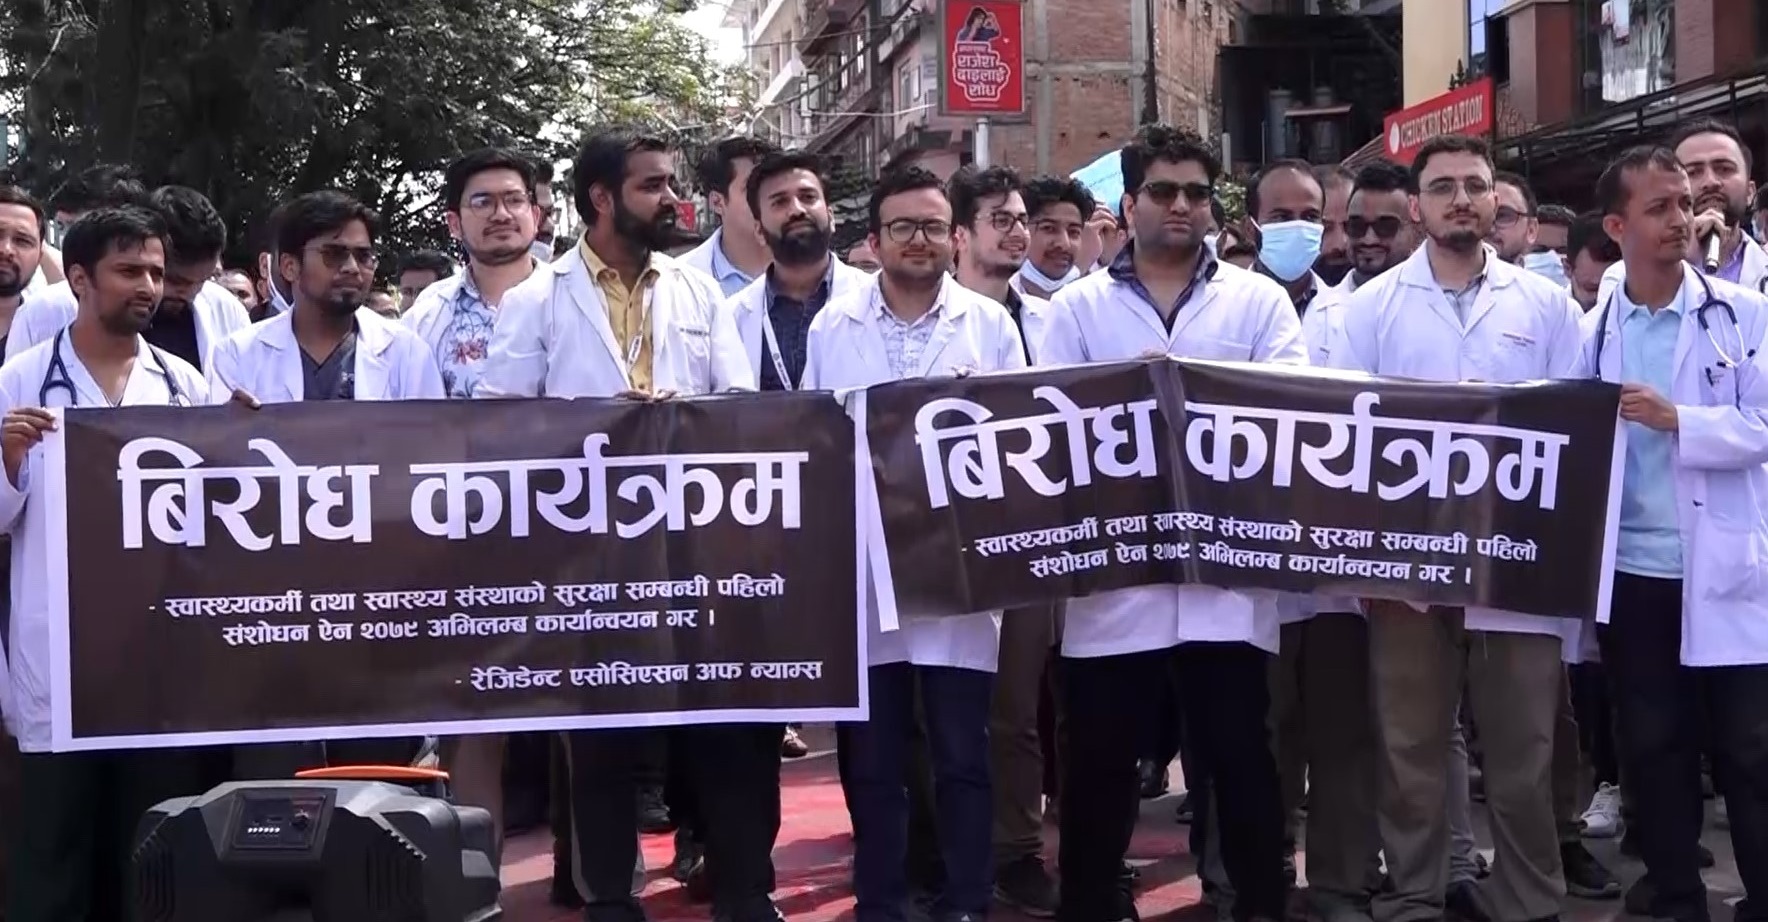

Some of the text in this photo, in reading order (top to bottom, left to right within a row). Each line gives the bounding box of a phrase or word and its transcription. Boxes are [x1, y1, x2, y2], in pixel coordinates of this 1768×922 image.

[956, 67, 1006, 84] दाइलाई
[957, 53, 996, 68] राजेश
[1401, 94, 1483, 148] CHICKEN STATION
[914, 385, 1570, 510] बिरोध कार्यक्रम
[117, 432, 809, 552] बिरोध कार्यक्रम
[974, 516, 1099, 557] स्वास्थ्यकर्मी
[1104, 515, 1148, 537] तथा
[1218, 515, 1304, 543] संस्थाको
[1309, 526, 1375, 548] सुरक्षा
[1380, 531, 1470, 554] सम्बन्धी
[1475, 534, 1538, 561] पहिलो
[1028, 548, 1109, 578] संशोधन
[1114, 543, 1148, 564] ऐन
[1198, 540, 1283, 570] अभिलम्ब
[1418, 564, 1455, 584] गर
[164, 589, 304, 618] स्वास्थ्यकर्मी
[309, 592, 357, 613] तथा
[362, 589, 448, 611] स्वास्थ्य
[454, 580, 547, 608] संस्थाको
[552, 580, 620, 607] सुरक्षा
[625, 574, 711, 601] सम्बन्धी
[716, 572, 786, 598] पहिलो
[222, 619, 311, 646] संशोधन
[317, 618, 354, 642] ऐन
[360, 620, 419, 640] २०७९
[426, 612, 529, 637] अभिलम्ब
[534, 608, 660, 632] कार्यान्वयन
[665, 609, 699, 628] गर
[470, 665, 563, 691] रेजिडेन्ट
[569, 661, 690, 686] एसोसिएसन
[695, 662, 744, 681] अफ
[750, 661, 823, 680] न्याम्स
